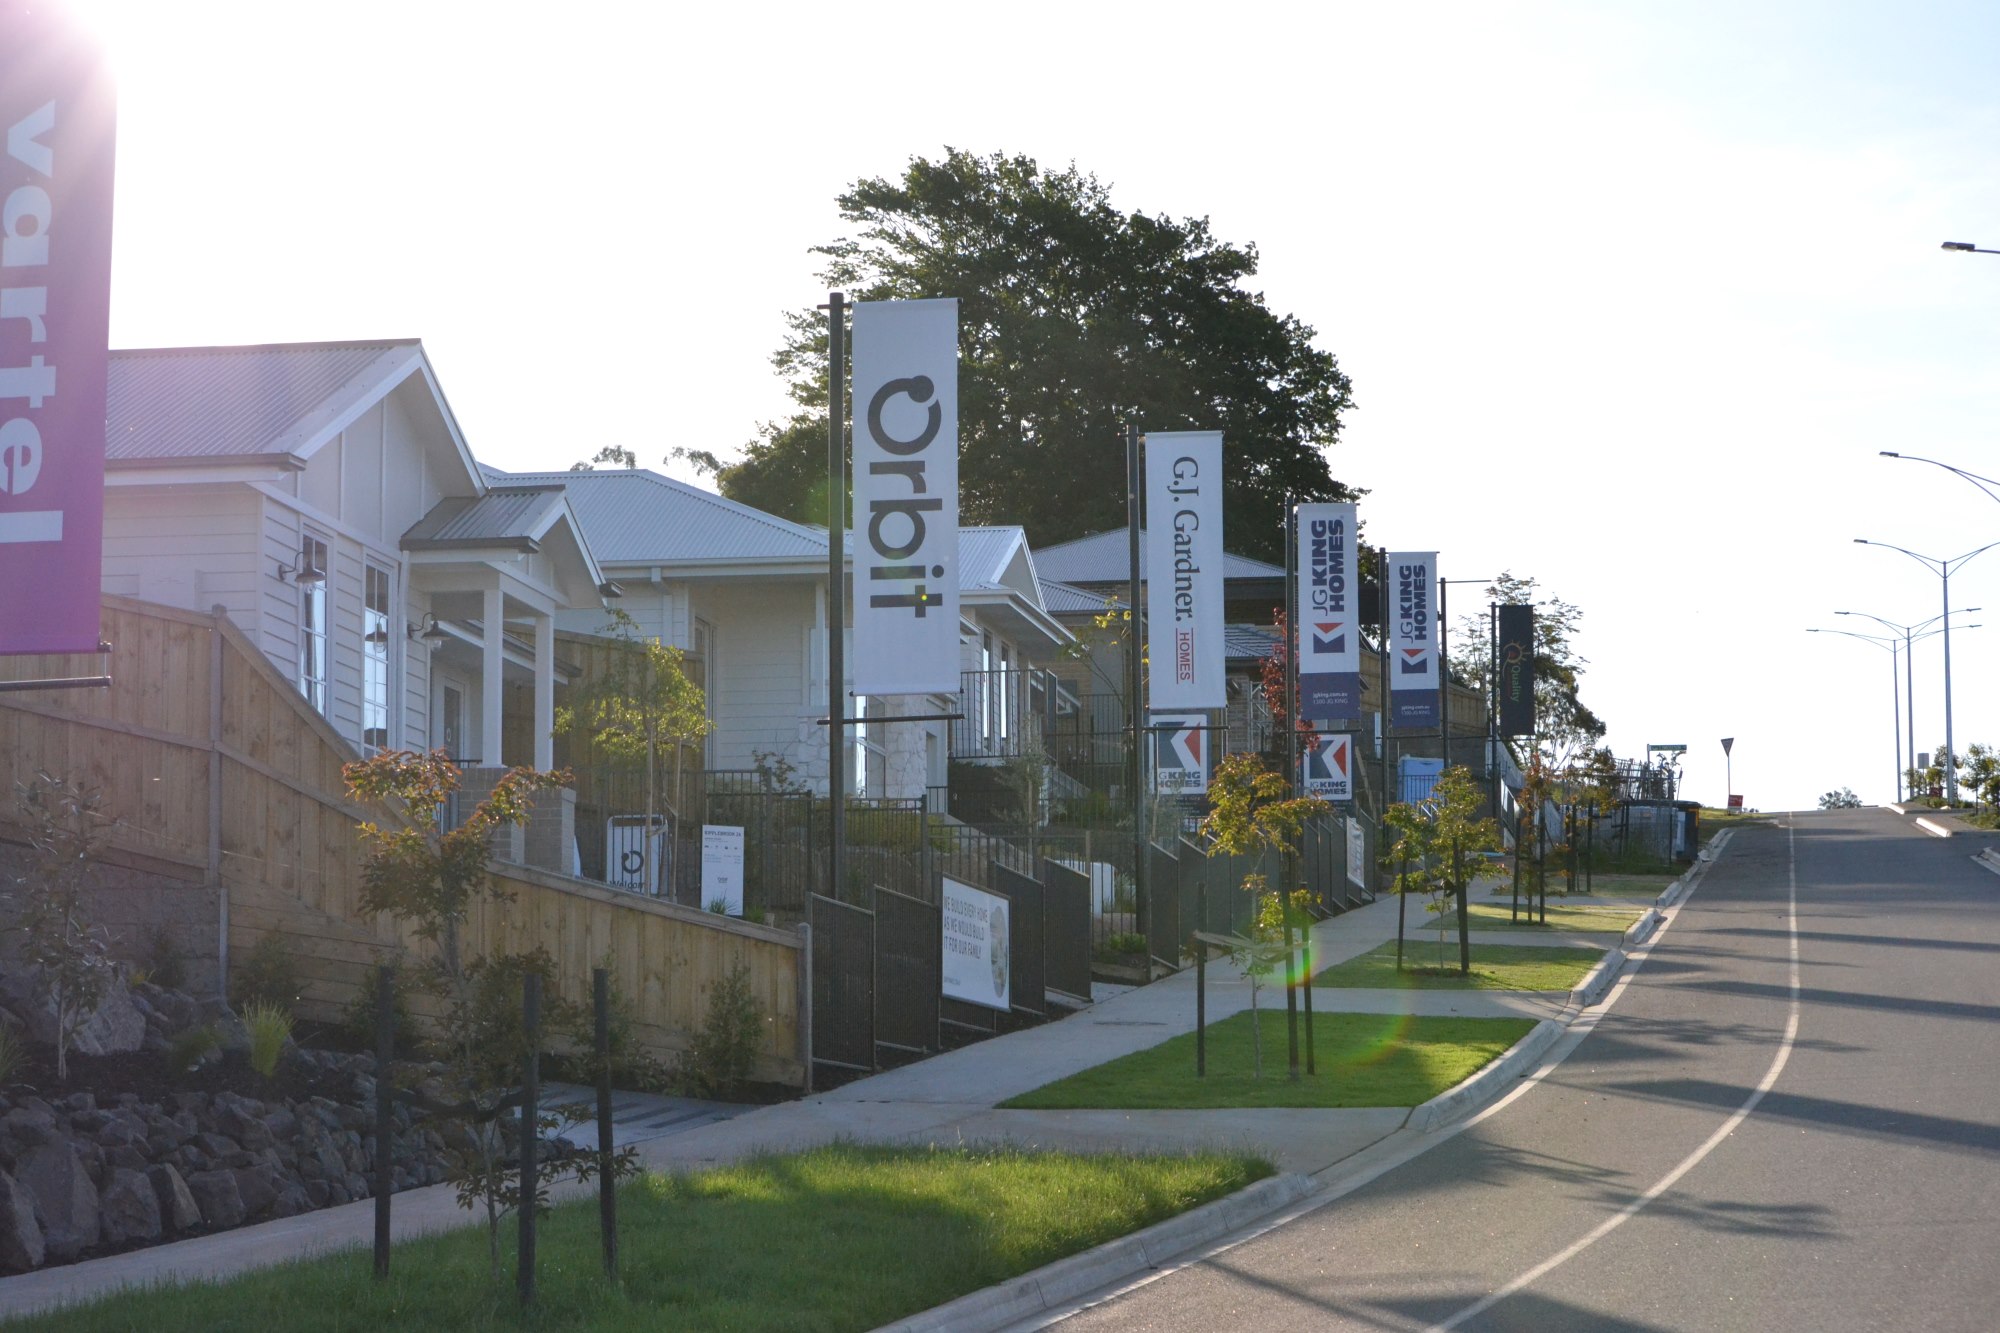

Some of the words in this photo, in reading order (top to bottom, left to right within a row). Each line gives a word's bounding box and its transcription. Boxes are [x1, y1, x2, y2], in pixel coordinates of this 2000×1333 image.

[867, 375, 943, 618] Orbit
[1167, 456, 1199, 502] G.J.
[1173, 509, 1200, 622] Gardner.
[1328, 519, 1345, 612] HOMES
[1413, 565, 1427, 640] HOMES
[1179, 632, 1191, 681] HOMES
[1510, 665, 1521, 702] Quality
